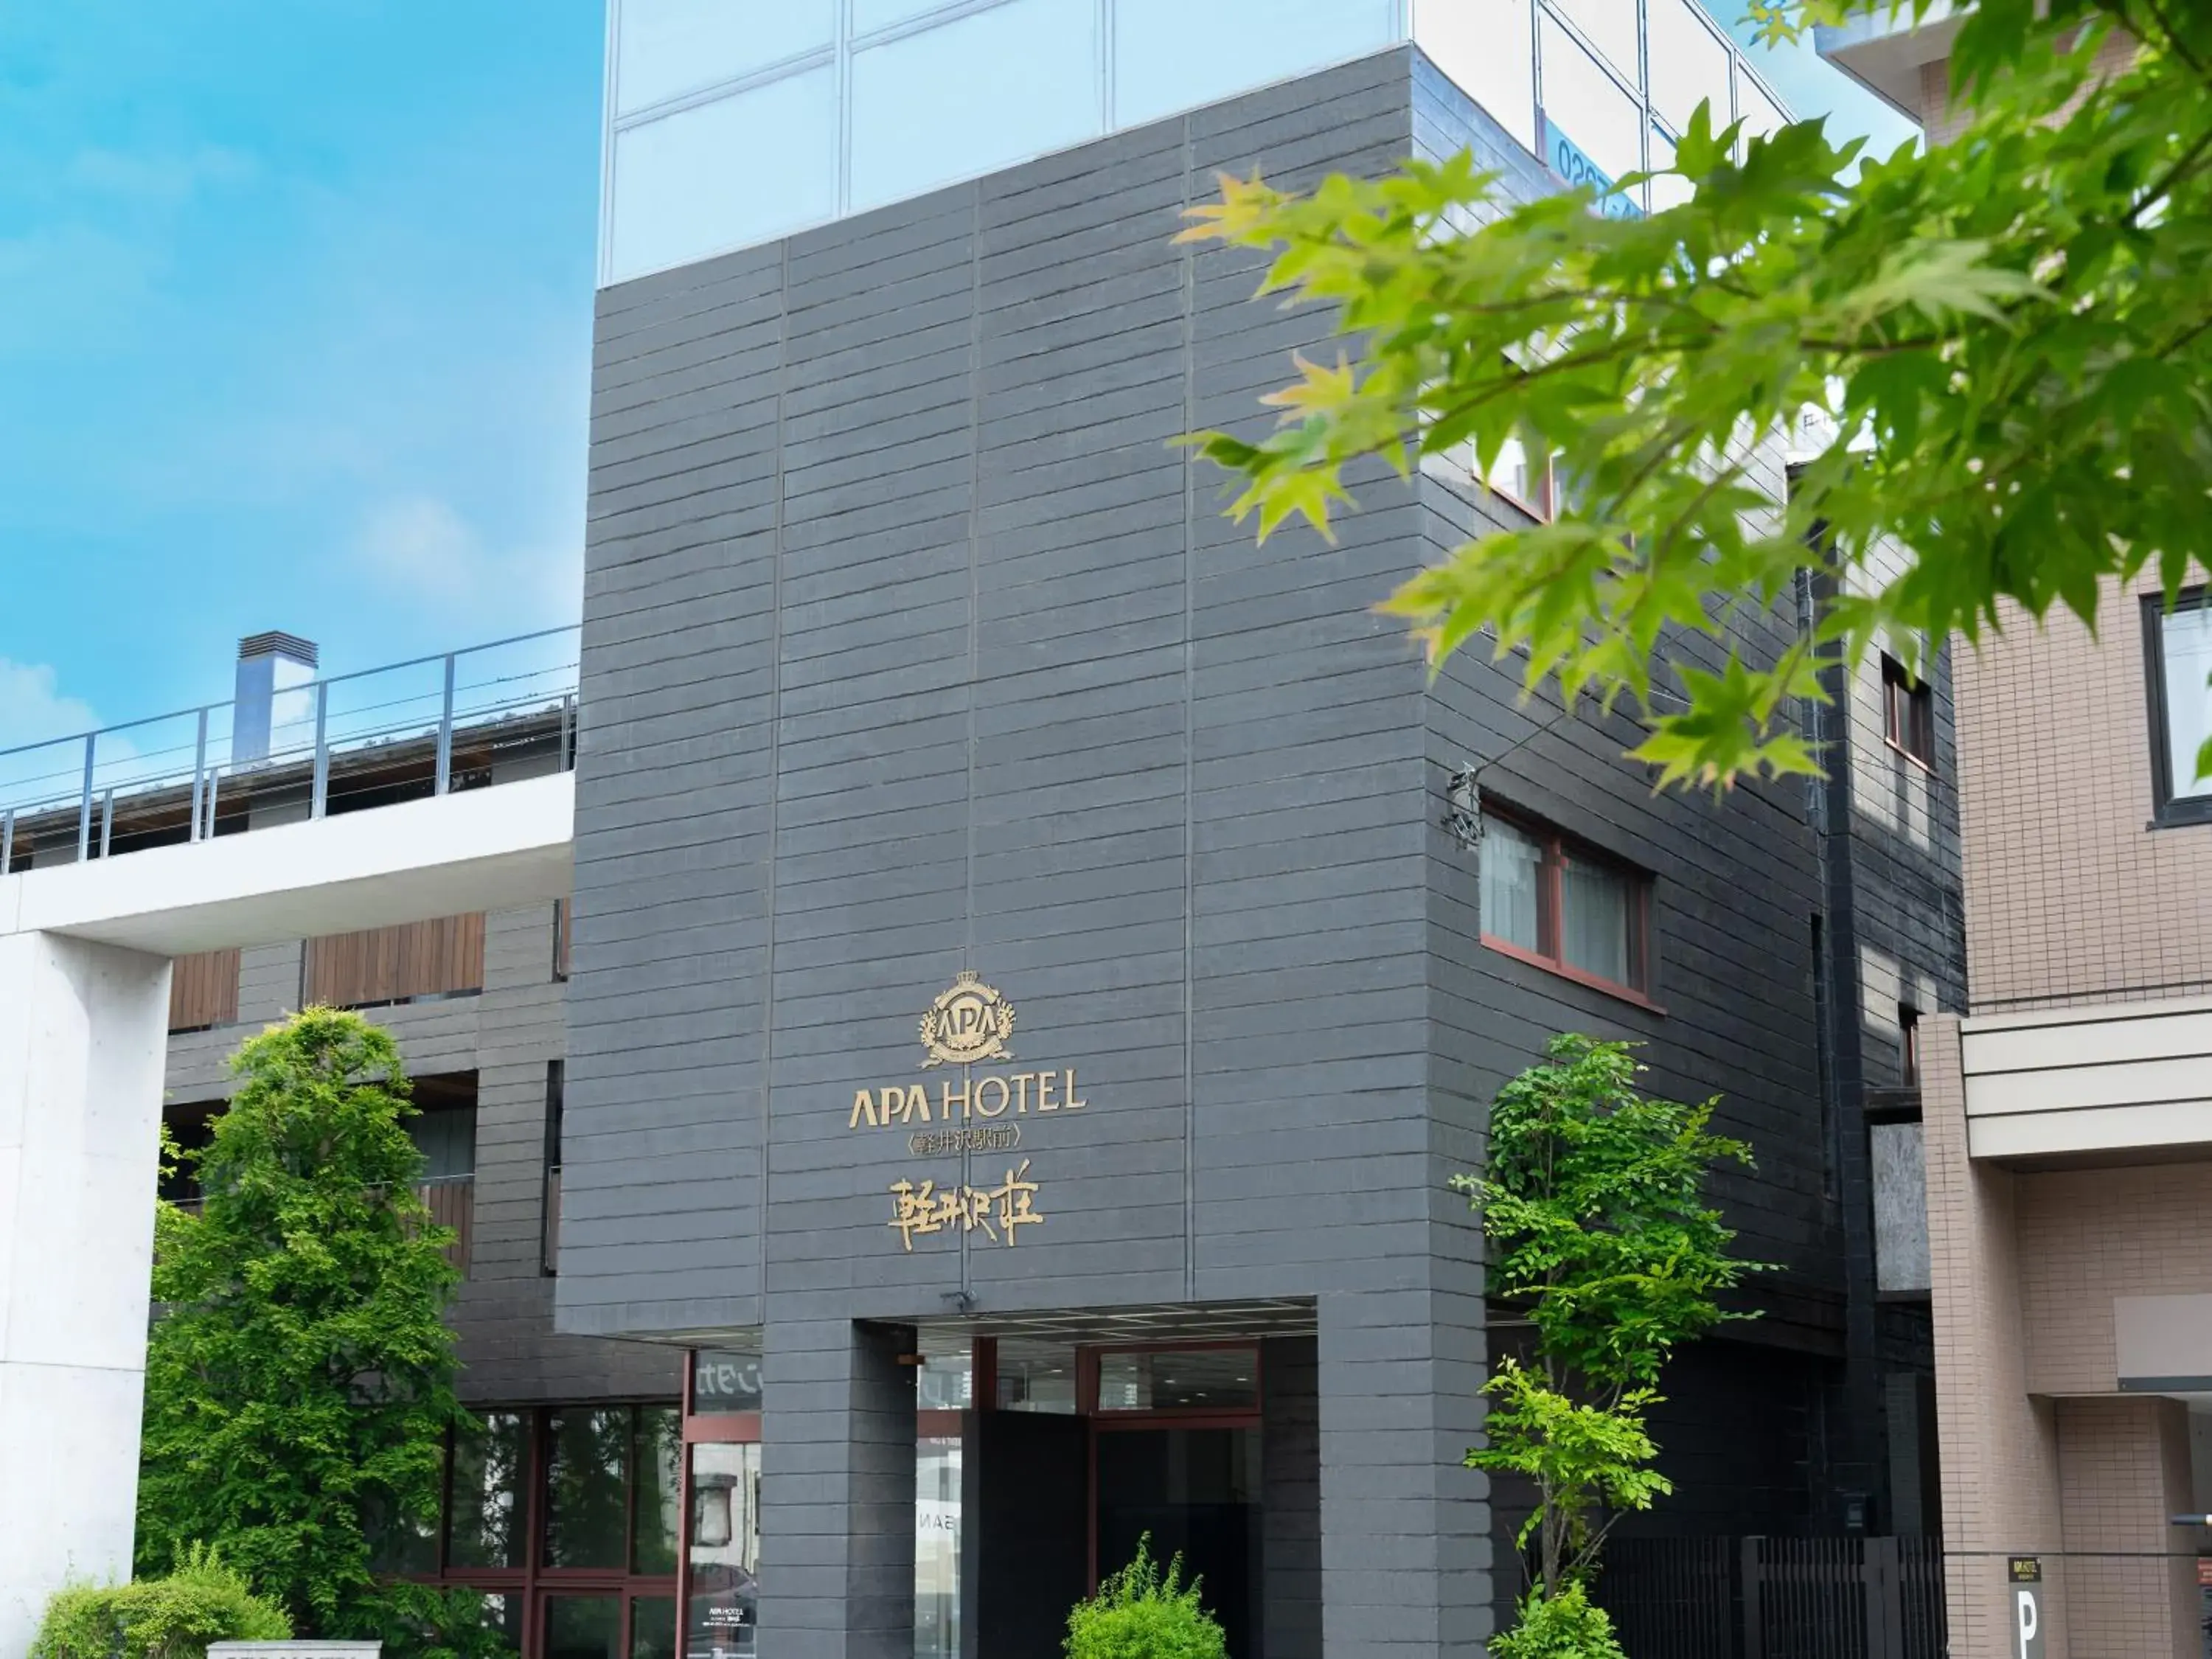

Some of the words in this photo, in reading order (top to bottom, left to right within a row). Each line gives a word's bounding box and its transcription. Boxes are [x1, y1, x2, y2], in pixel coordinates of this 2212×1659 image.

[936, 1005, 997, 1037] APA
[849, 1084, 931, 1128] APA
[942, 1069, 1088, 1120] HOTEL
[2017, 1590, 2037, 1659] P
